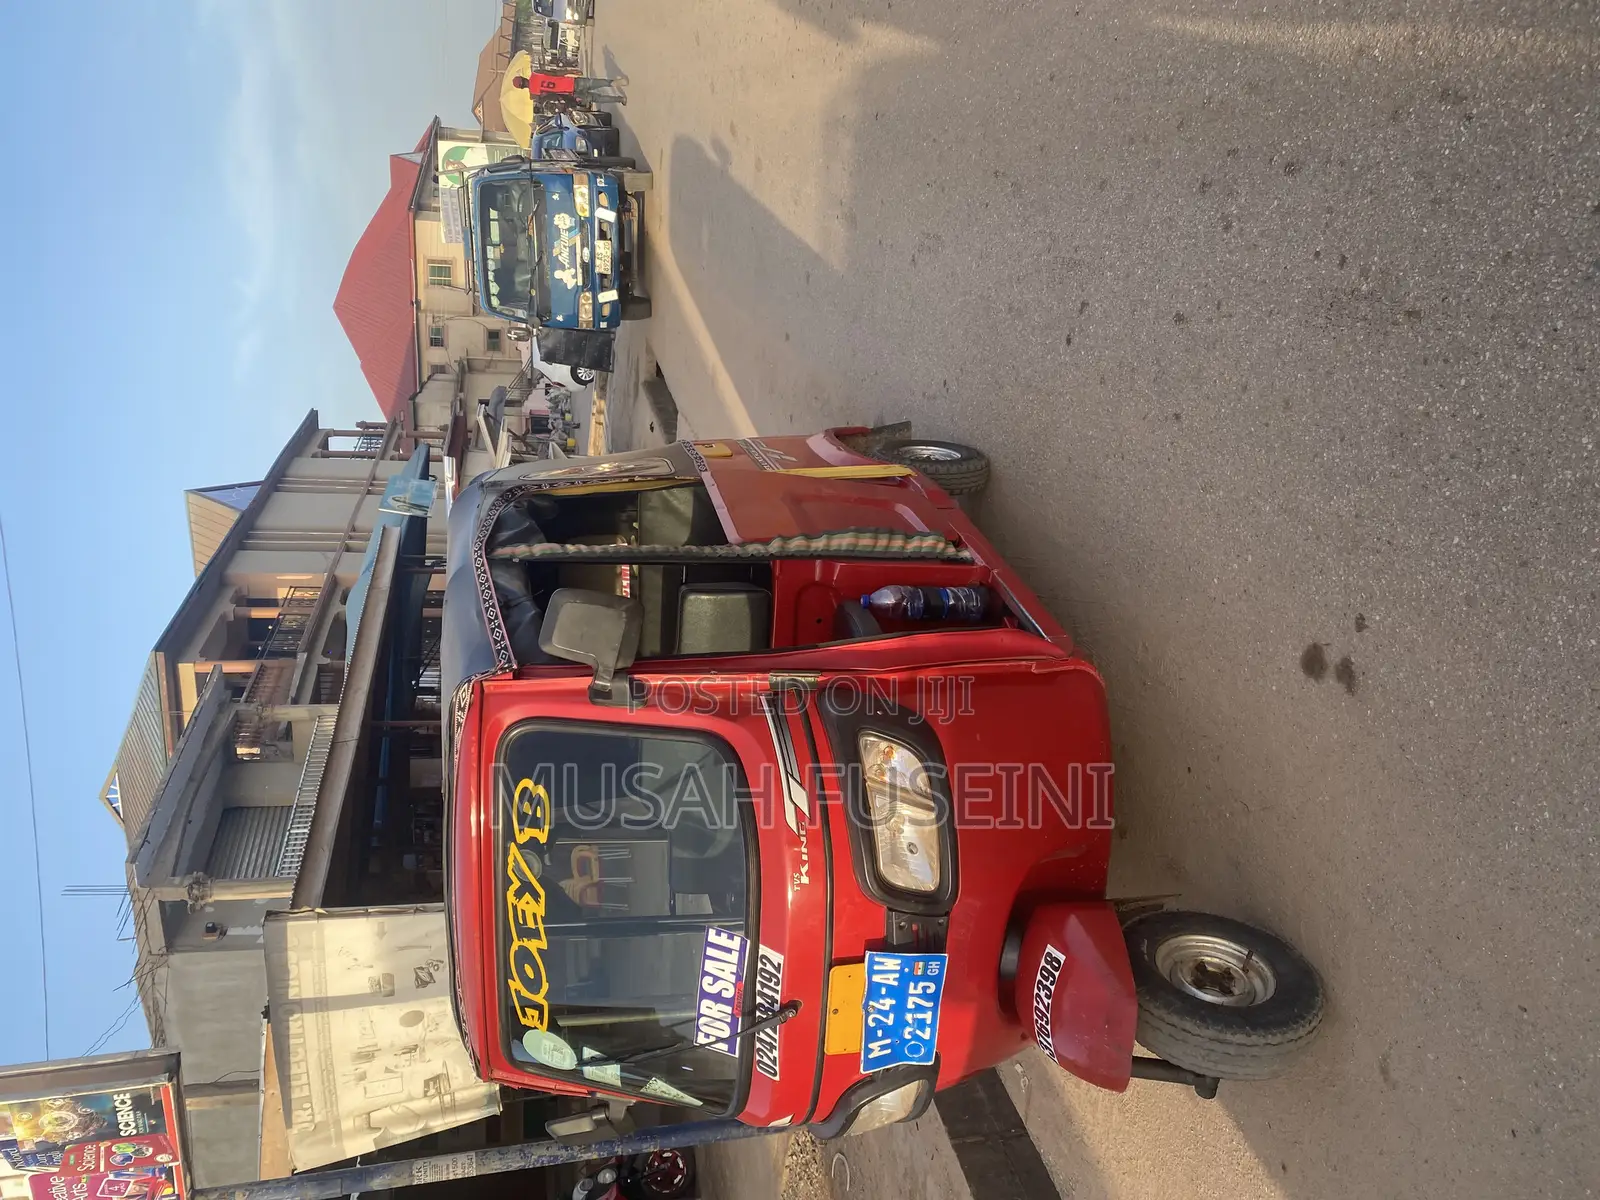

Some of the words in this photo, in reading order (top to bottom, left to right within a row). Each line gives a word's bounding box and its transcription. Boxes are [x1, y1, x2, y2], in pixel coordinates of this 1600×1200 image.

[512, 778, 550, 844] B
[508, 842, 548, 1032] JOEY
[702, 928, 741, 998] SALE
[697, 1000, 732, 1051] FOR
[867, 957, 901, 1058] M-24-AW
[903, 982, 936, 1040] 2175
[927, 961, 940, 976] GH
[1034, 951, 1062, 1064] 37692398
[113, 1093, 137, 1136] SCIENCE
[77, 1144, 96, 1172] Science
